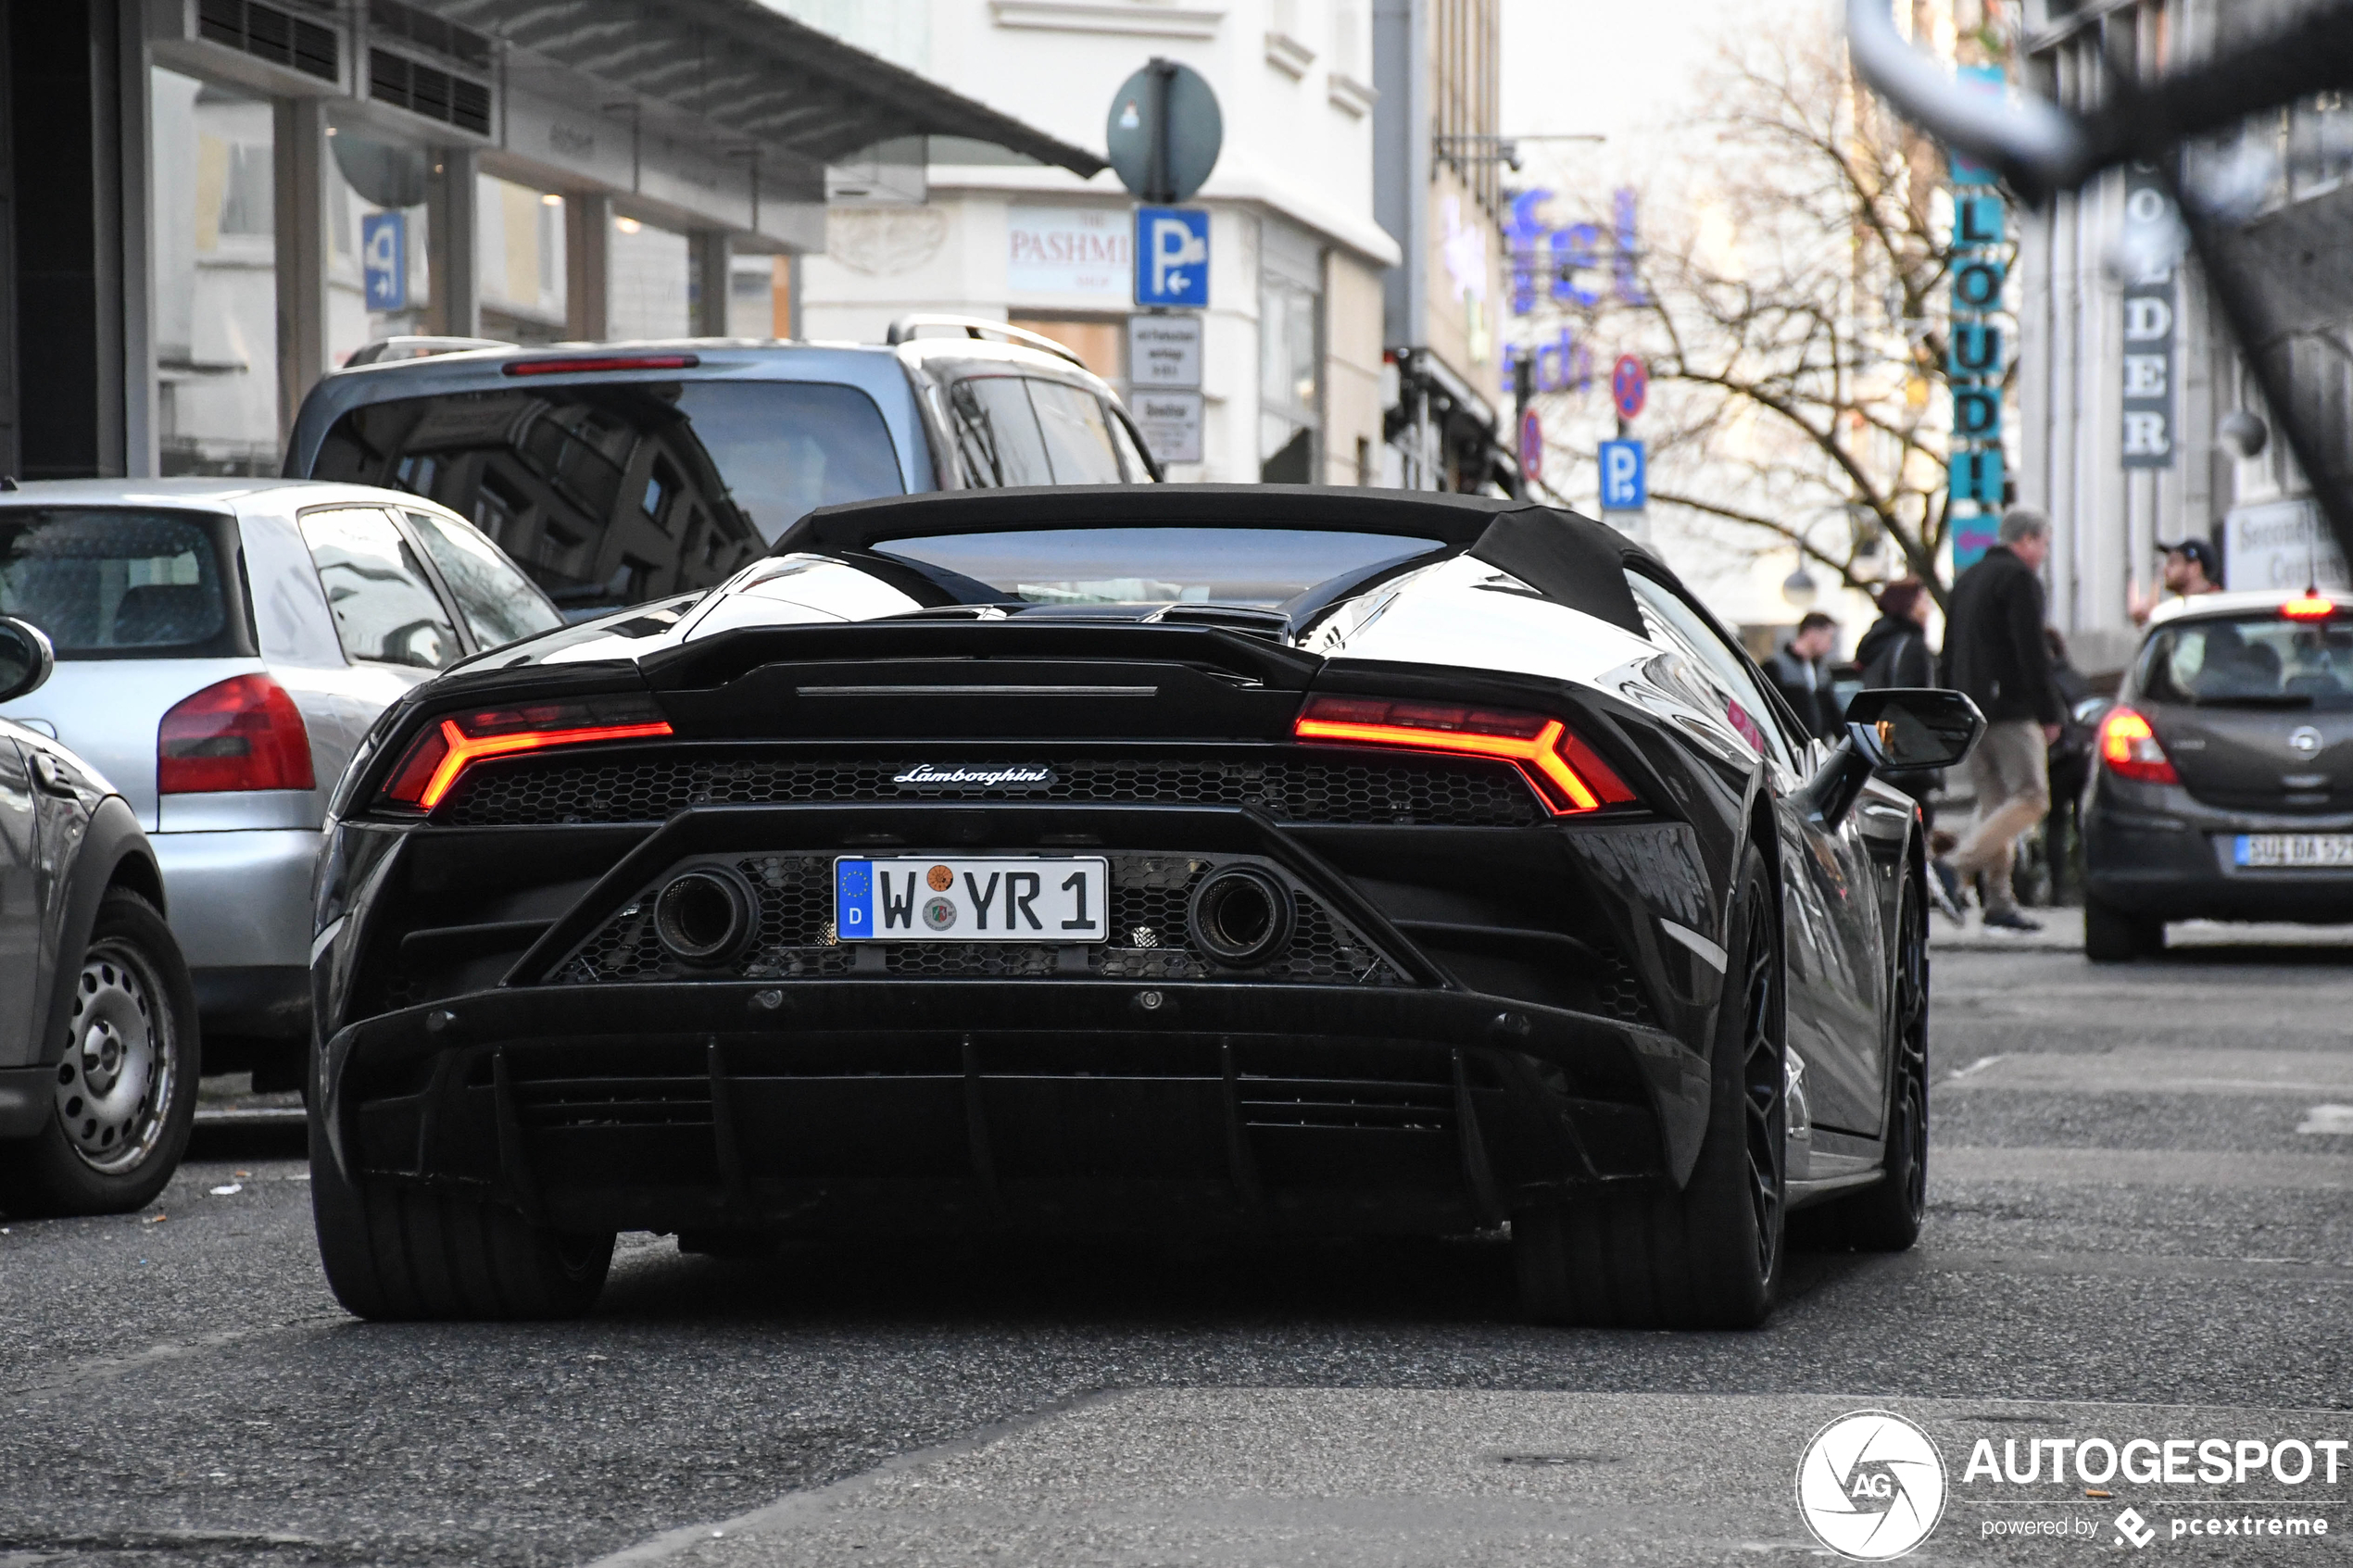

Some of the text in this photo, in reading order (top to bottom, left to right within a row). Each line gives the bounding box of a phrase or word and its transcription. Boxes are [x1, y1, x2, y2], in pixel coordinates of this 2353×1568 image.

[894, 764, 1049, 786] Lamborghini
[880, 871, 916, 929] W
[963, 872, 1043, 930] YR
[1061, 872, 1097, 930] 1
[849, 908, 862, 925] D
